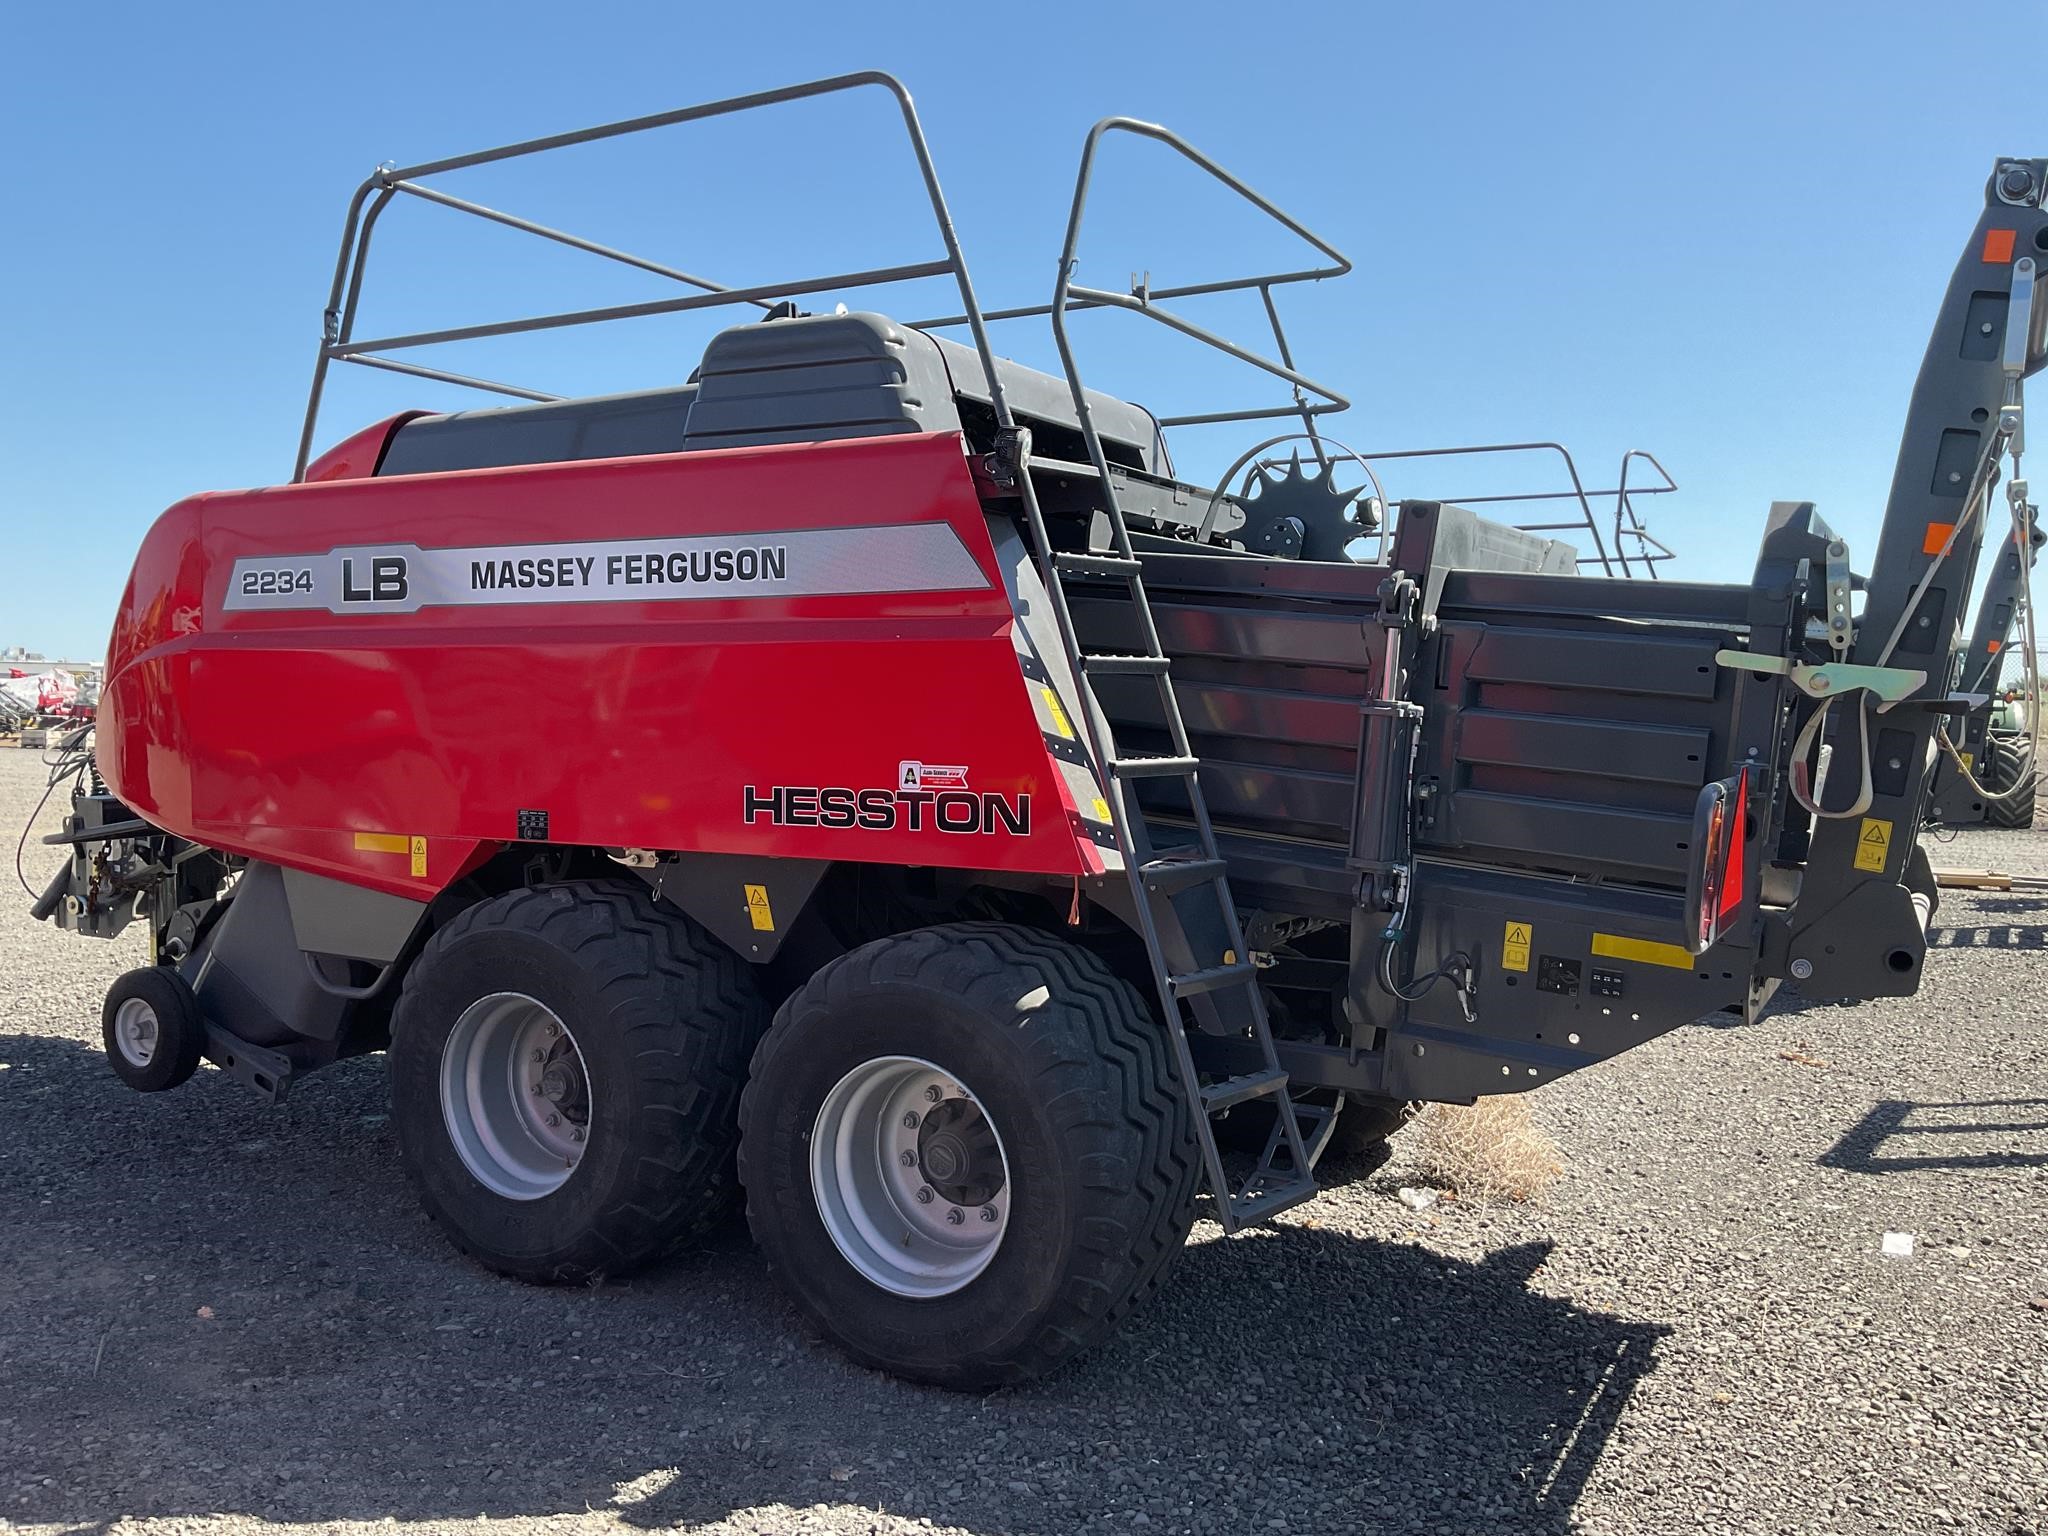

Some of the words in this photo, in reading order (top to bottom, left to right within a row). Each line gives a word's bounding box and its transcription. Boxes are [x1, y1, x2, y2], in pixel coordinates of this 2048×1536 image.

[242, 569, 314, 596] 2234
[342, 556, 409, 603] LB
[470, 555, 596, 591] MASSEY
[605, 545, 788, 587] FERGUSON
[744, 785, 1031, 836] HESSTON
